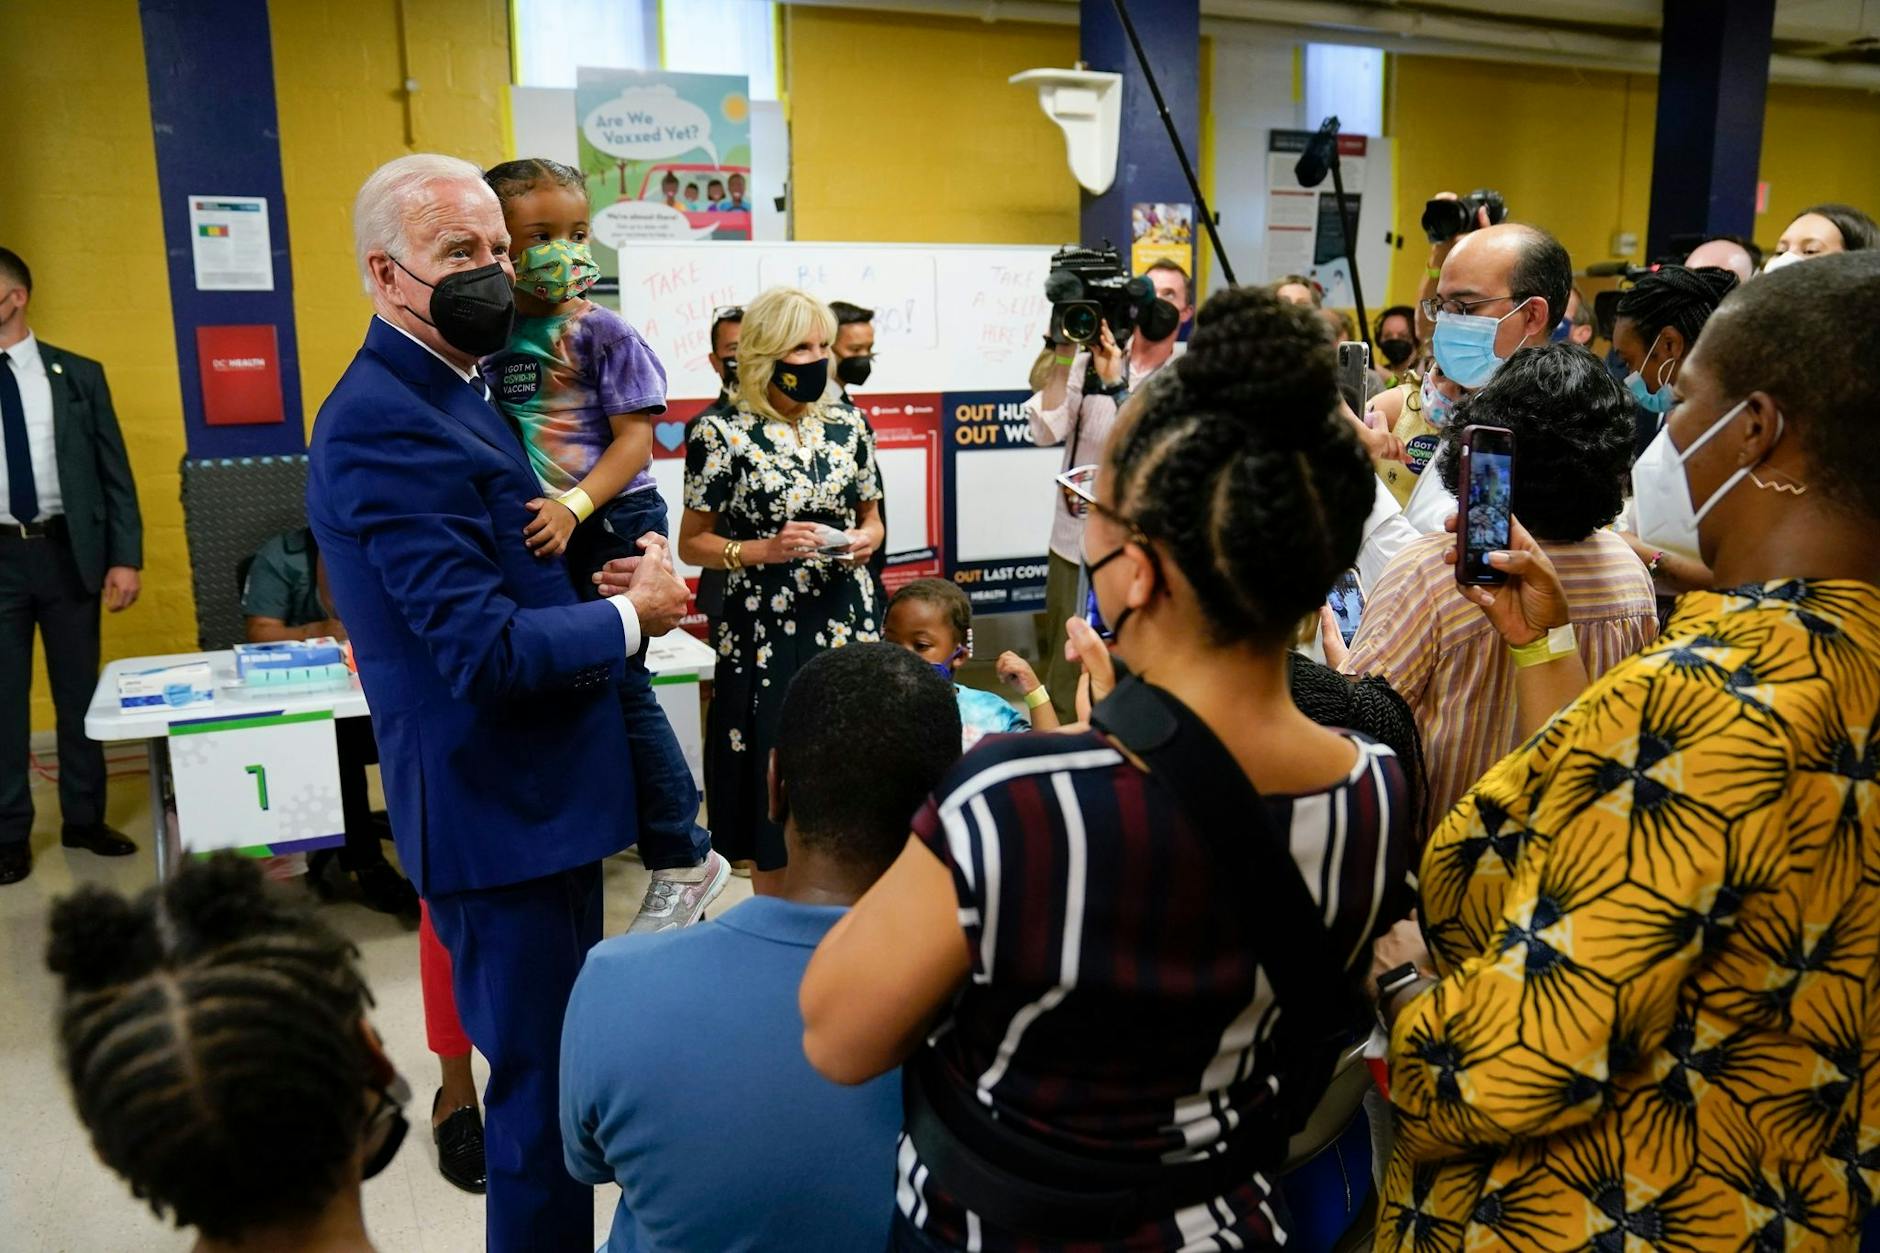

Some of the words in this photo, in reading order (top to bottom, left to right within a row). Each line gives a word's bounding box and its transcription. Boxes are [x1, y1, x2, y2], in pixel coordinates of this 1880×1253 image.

[596, 114, 623, 128] Are
[627, 111, 654, 125] We
[602, 127, 661, 145] Vaxxed
[664, 124, 699, 140] Yet?
[642, 259, 703, 303] TAKE
[990, 265, 1035, 288] TAKE
[229, 358, 265, 368] HEALTH
[508, 364, 523, 373] GOT
[525, 363, 537, 371] MY
[503, 373, 537, 384] COVID-19
[503, 383, 537, 394] VACCINE
[955, 404, 996, 422] OUT
[955, 424, 1000, 445] OUT
[954, 569, 982, 583] OUT
[983, 566, 1016, 582] LAST
[970, 588, 1007, 600] HEALTH
[245, 764, 268, 811] 1
